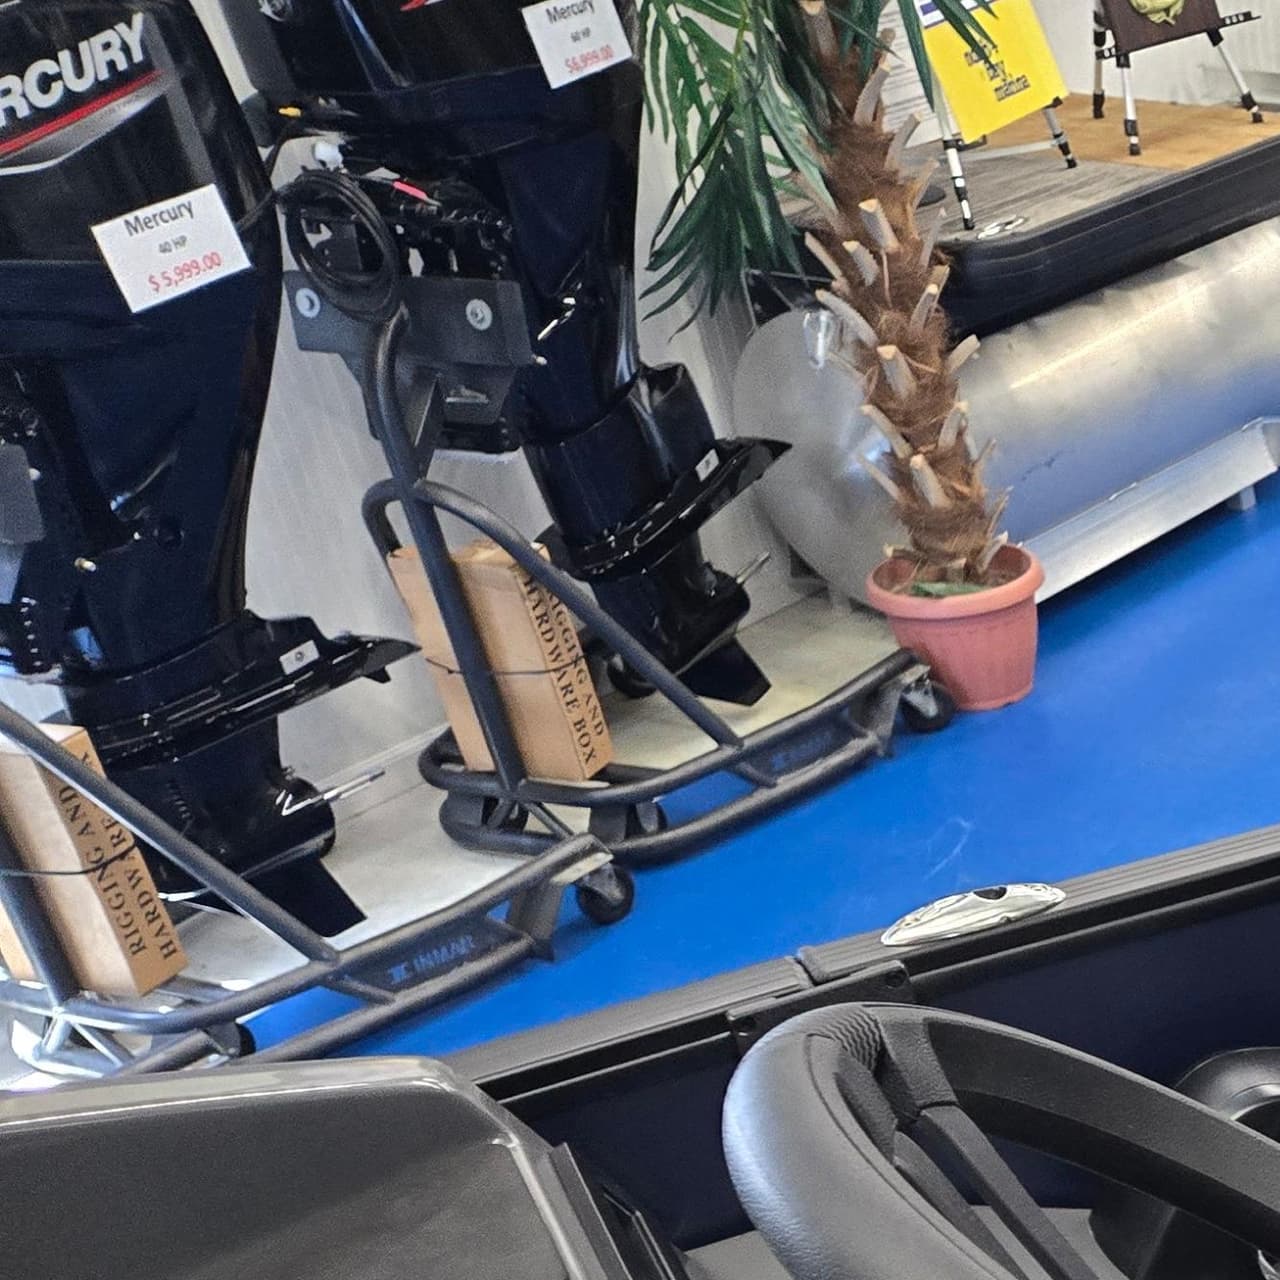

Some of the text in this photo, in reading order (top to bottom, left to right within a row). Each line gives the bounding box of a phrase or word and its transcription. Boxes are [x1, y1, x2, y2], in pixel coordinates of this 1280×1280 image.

[124, 200, 195, 237] Mercury
[172, 234, 188, 250] HP
[573, 718, 597, 764] BOX
